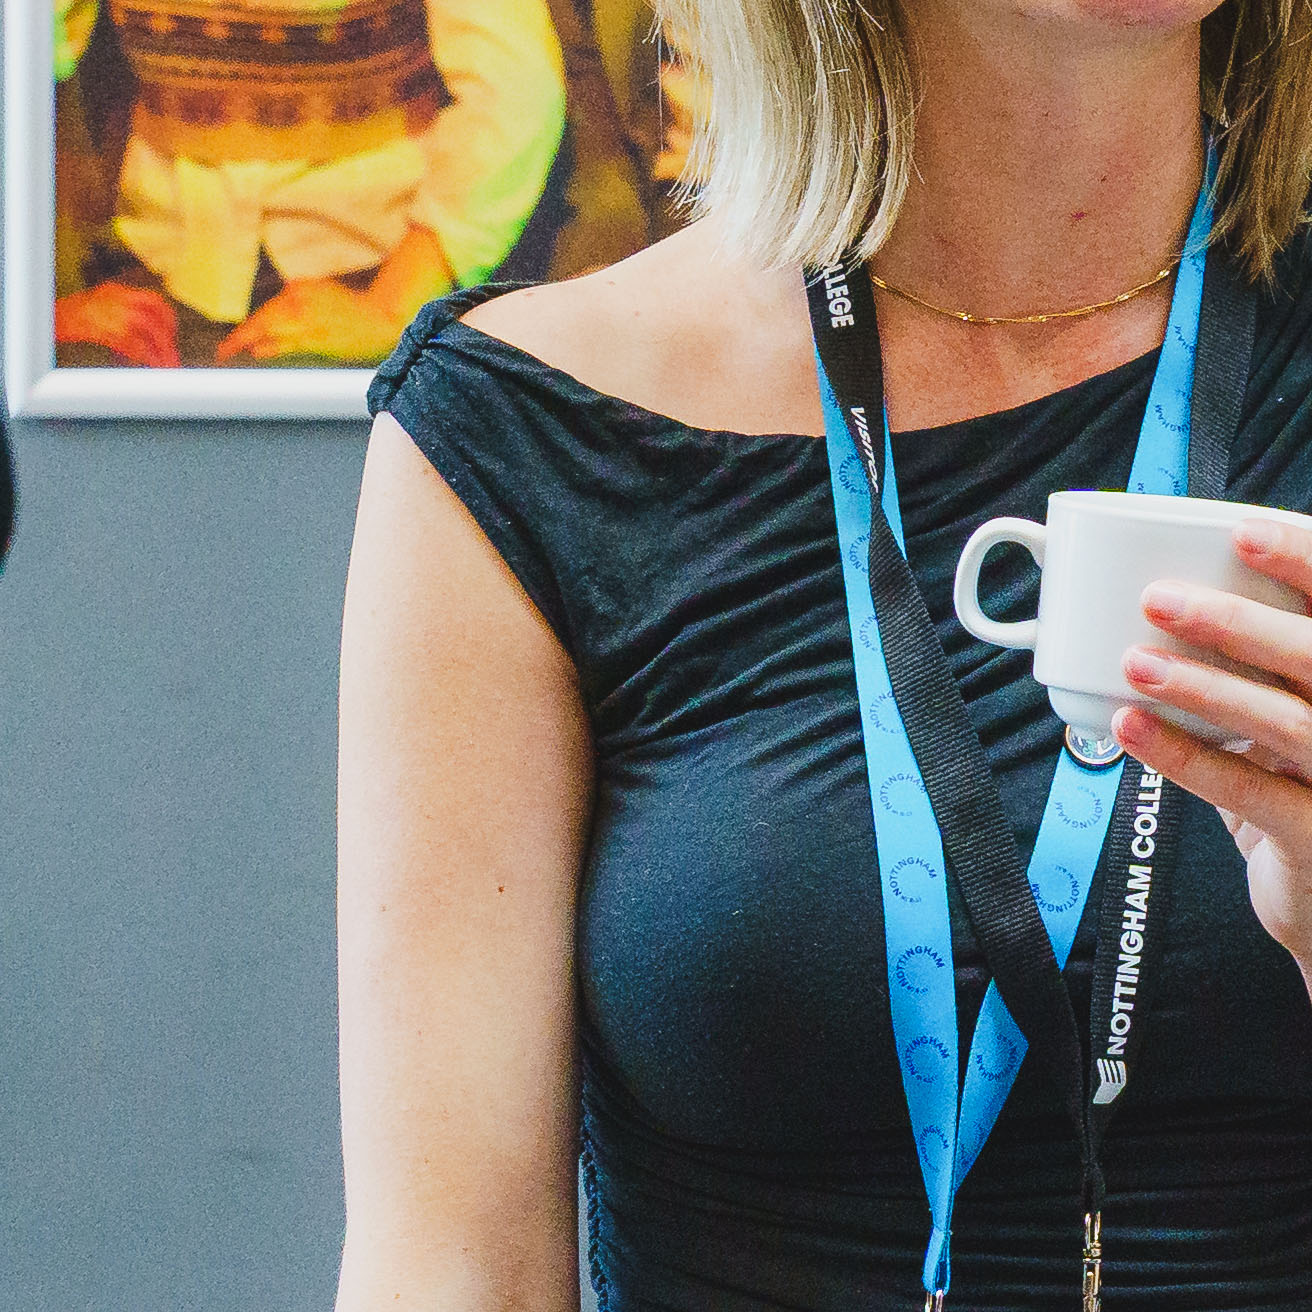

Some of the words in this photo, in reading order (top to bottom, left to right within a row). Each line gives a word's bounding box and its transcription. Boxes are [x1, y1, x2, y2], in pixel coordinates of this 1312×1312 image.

[823, 263, 854, 328] LLEGE
[1054, 798, 1103, 829] NOTTINGHAM
[889, 856, 937, 896] NOTTINGHAM
[1106, 864, 1152, 1056] NOTTINGHAM
[1131, 763, 1164, 859] COLLE
[896, 945, 946, 987] NOTTINGHAM
